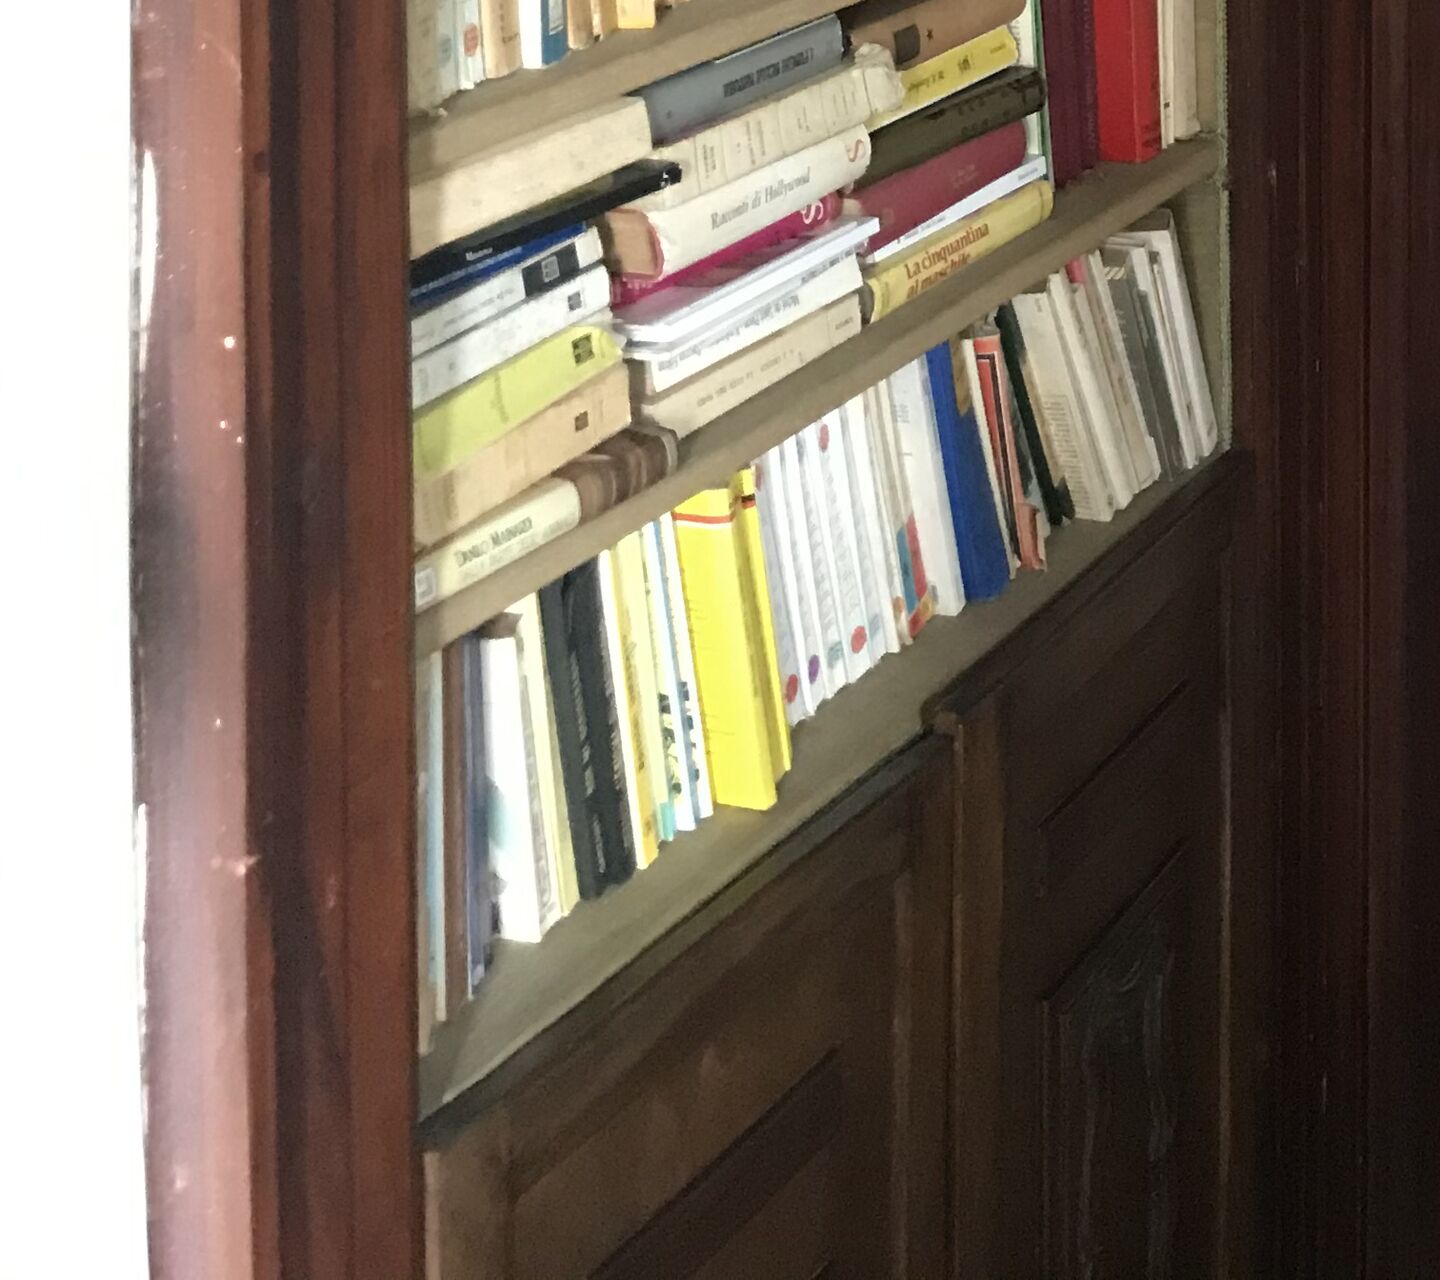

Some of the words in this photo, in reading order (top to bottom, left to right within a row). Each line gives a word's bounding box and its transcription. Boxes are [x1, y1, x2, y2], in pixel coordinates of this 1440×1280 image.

[764, 165, 811, 204] Hollywood
[904, 259, 922, 281] La
[920, 222, 990, 268] cinquantina
